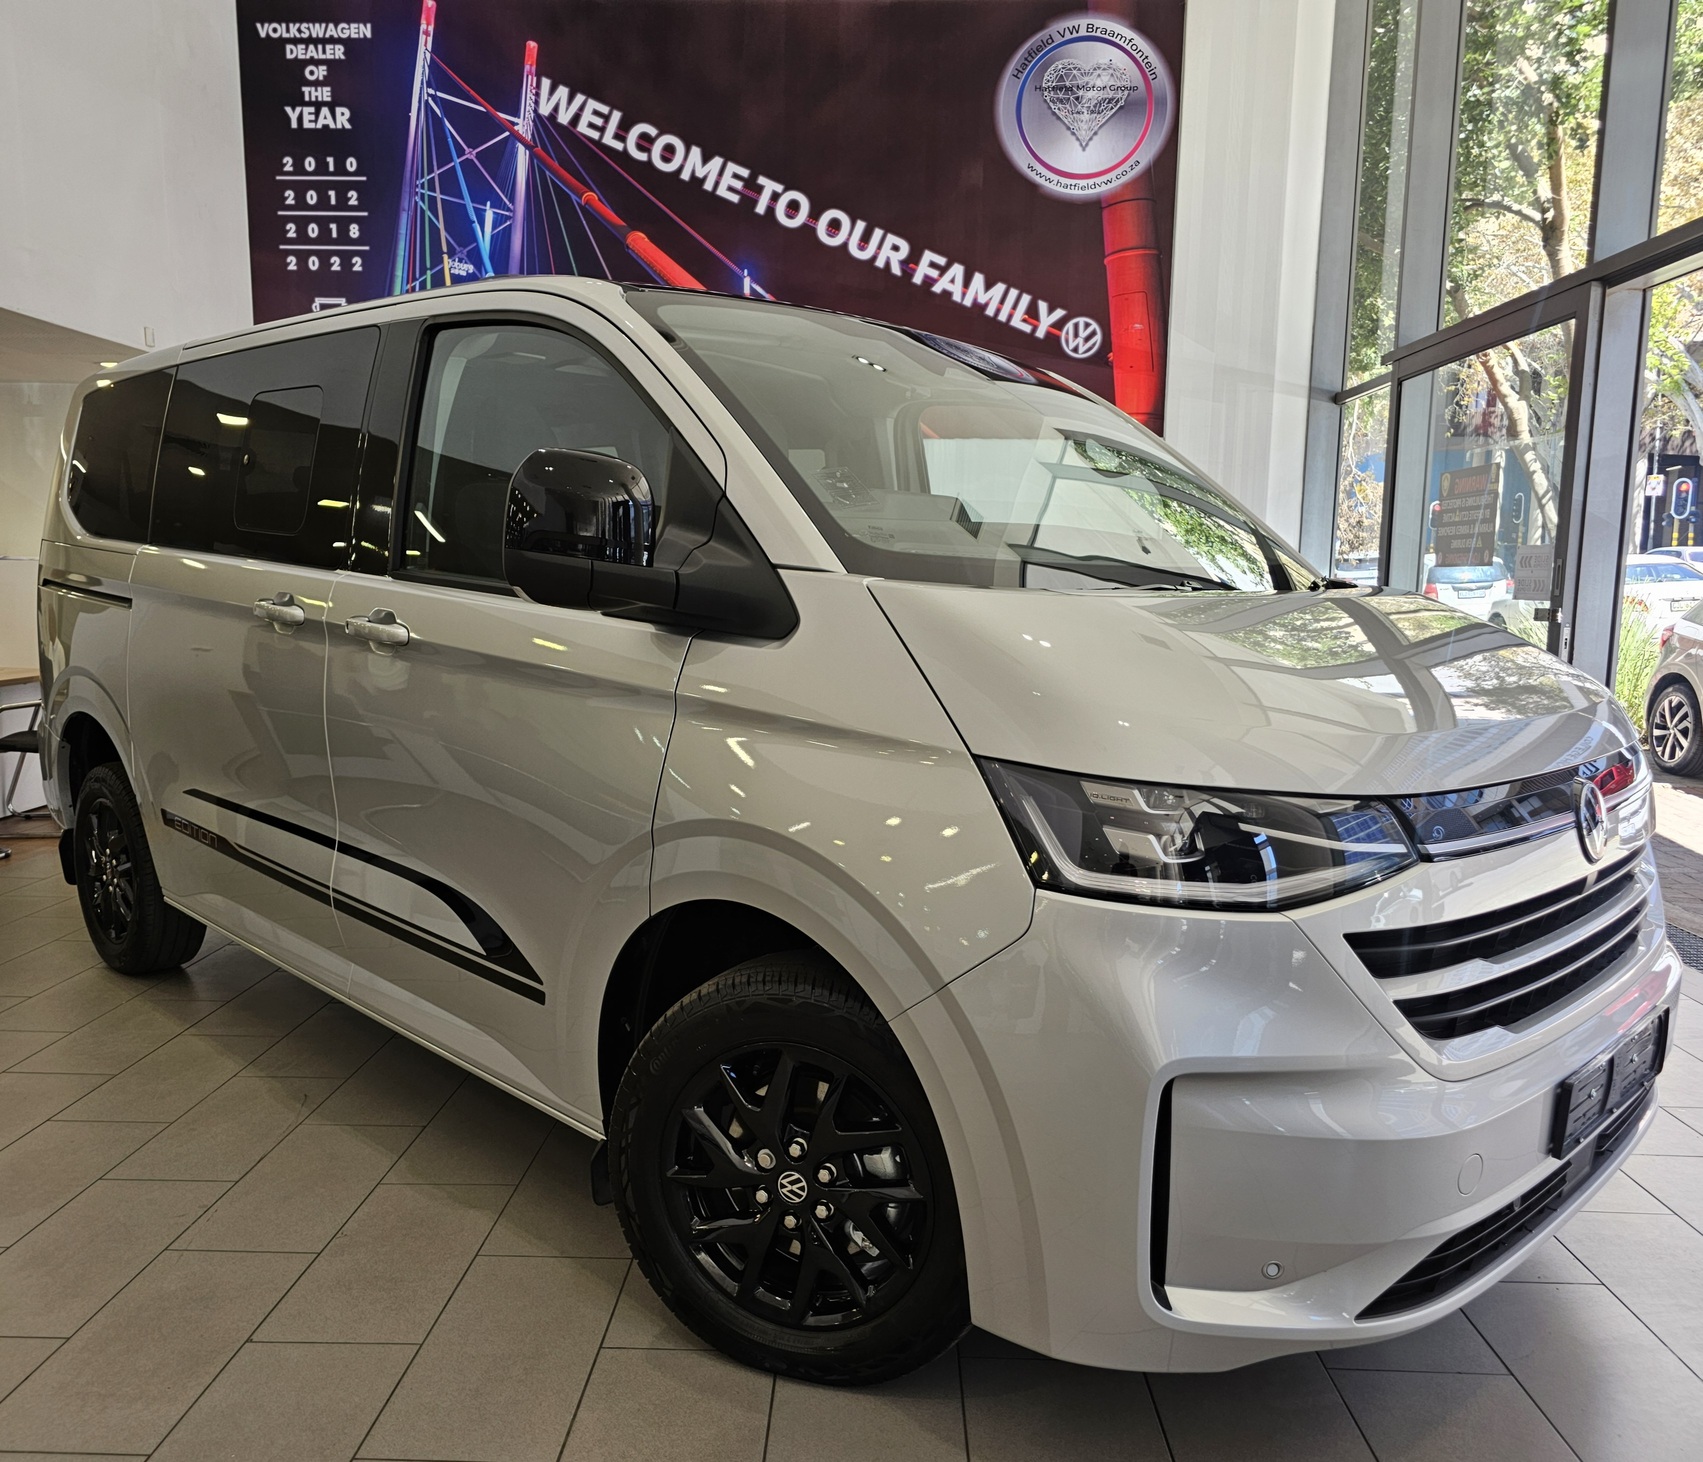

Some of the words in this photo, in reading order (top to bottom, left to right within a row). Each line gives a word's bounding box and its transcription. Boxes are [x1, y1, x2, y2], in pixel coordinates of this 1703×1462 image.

[256, 22, 372, 39] VOLKSWAGEN
[285, 44, 346, 60] DEALER
[1012, 34, 1055, 80] Hatfield
[1056, 24, 1081, 39] VW
[1086, 23, 1158, 81] Braamfontein
[304, 65, 328, 81] OF
[301, 86, 332, 102] THE
[1076, 84, 1106, 92] Motor
[1109, 84, 1139, 92] Group
[284, 106, 352, 129] YEAR
[1027, 159, 1141, 192] www.hatfieldvw.co.za
[538, 76, 750, 203] WELCOME
[755, 175, 810, 228] TO
[816, 208, 910, 277] OUR
[912, 249, 1067, 340] FAMILY
[174, 816, 218, 848] EDITION
